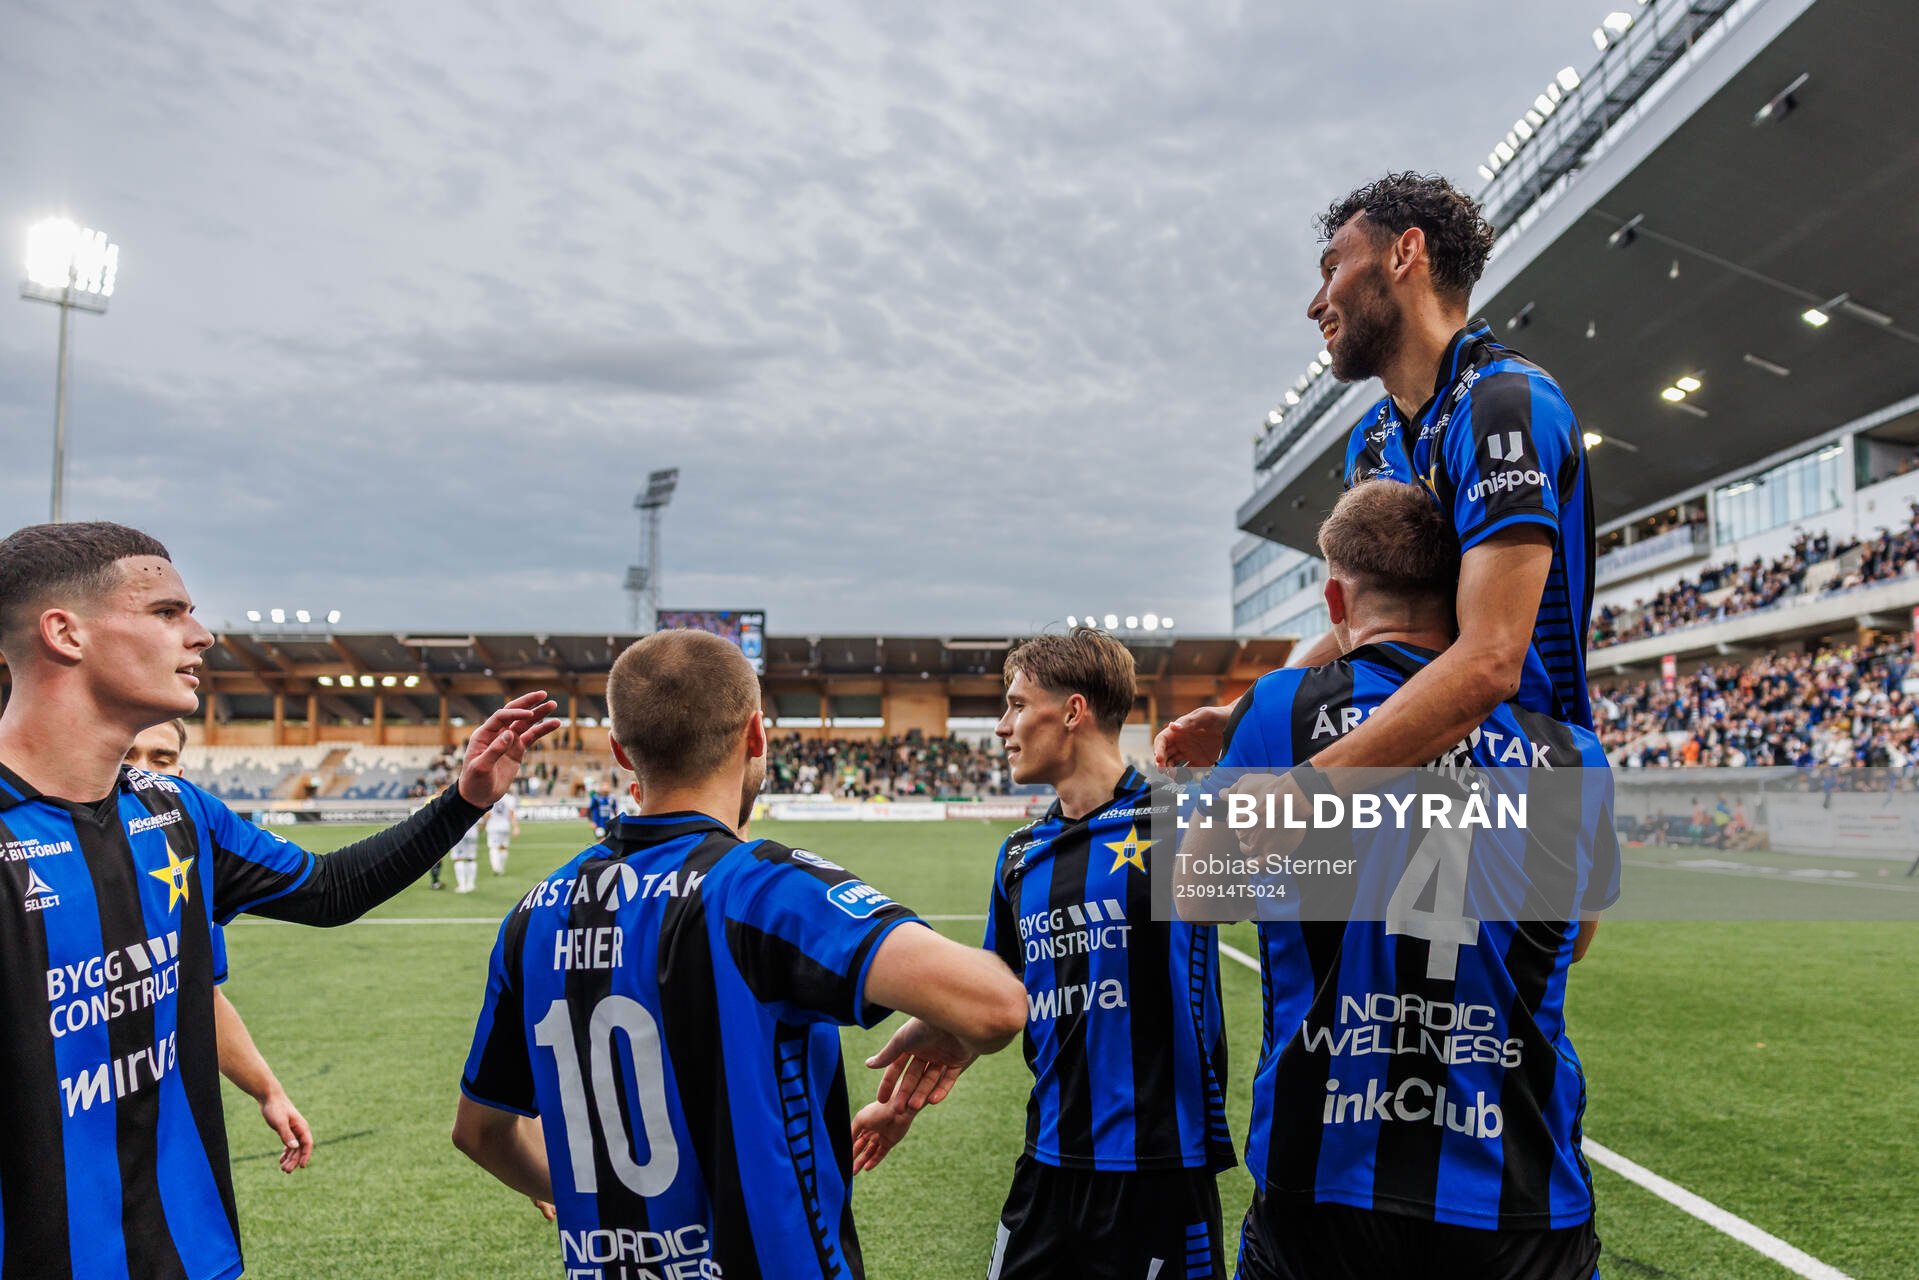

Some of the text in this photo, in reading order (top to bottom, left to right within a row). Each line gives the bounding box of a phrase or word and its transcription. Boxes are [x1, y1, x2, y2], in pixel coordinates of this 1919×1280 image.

[1482, 730, 1555, 772] TAK
[8, 840, 73, 862] BILFORUM
[24, 894, 61, 912] SELECT
[1385, 799, 1480, 981] 4
[1019, 908, 1064, 941] BYGG
[1025, 925, 1133, 965] ONSTRUCT
[553, 926, 624, 970] HEIER
[46, 950, 123, 1002] BYGG
[50, 961, 180, 1039] CONSTRUCT
[1027, 978, 1128, 1022] mirva
[1340, 993, 1496, 1031] NORDIC
[1303, 1019, 1524, 1068] WELLNESS
[61, 1030, 176, 1118] mirva
[534, 994, 679, 1198] 10
[1322, 1077, 1504, 1139] inkClub
[560, 1224, 710, 1263] NORDIC
